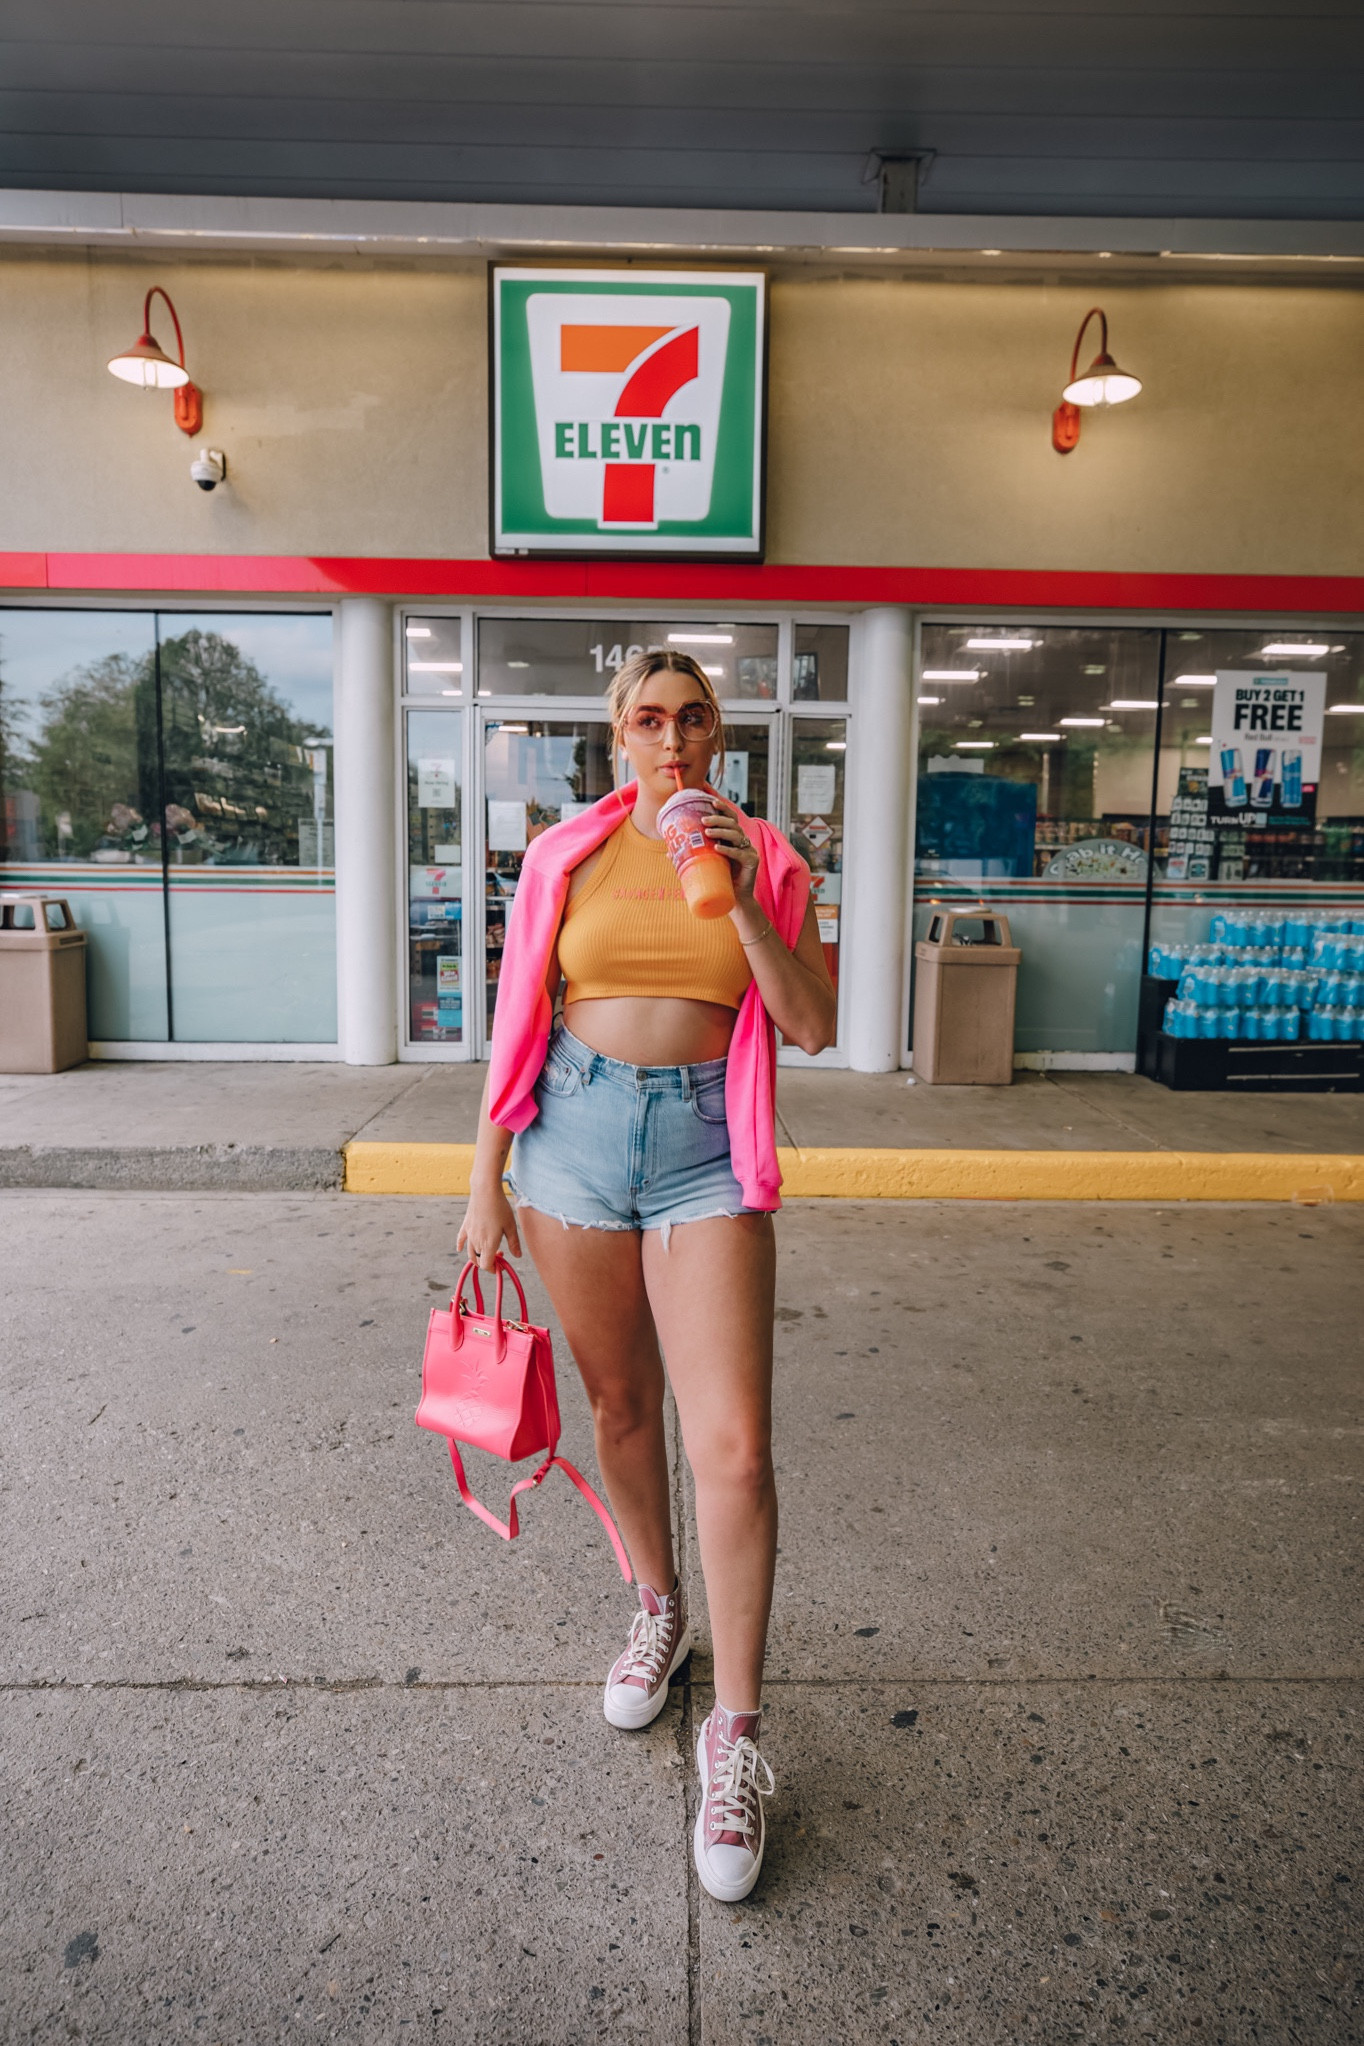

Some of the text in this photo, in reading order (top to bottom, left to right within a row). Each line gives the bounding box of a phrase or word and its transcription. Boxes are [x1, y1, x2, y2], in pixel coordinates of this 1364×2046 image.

[561, 324, 699, 522] 7
[1236, 688, 1305, 702] BUY 2 GET 1
[1233, 703, 1303, 731] FREE
